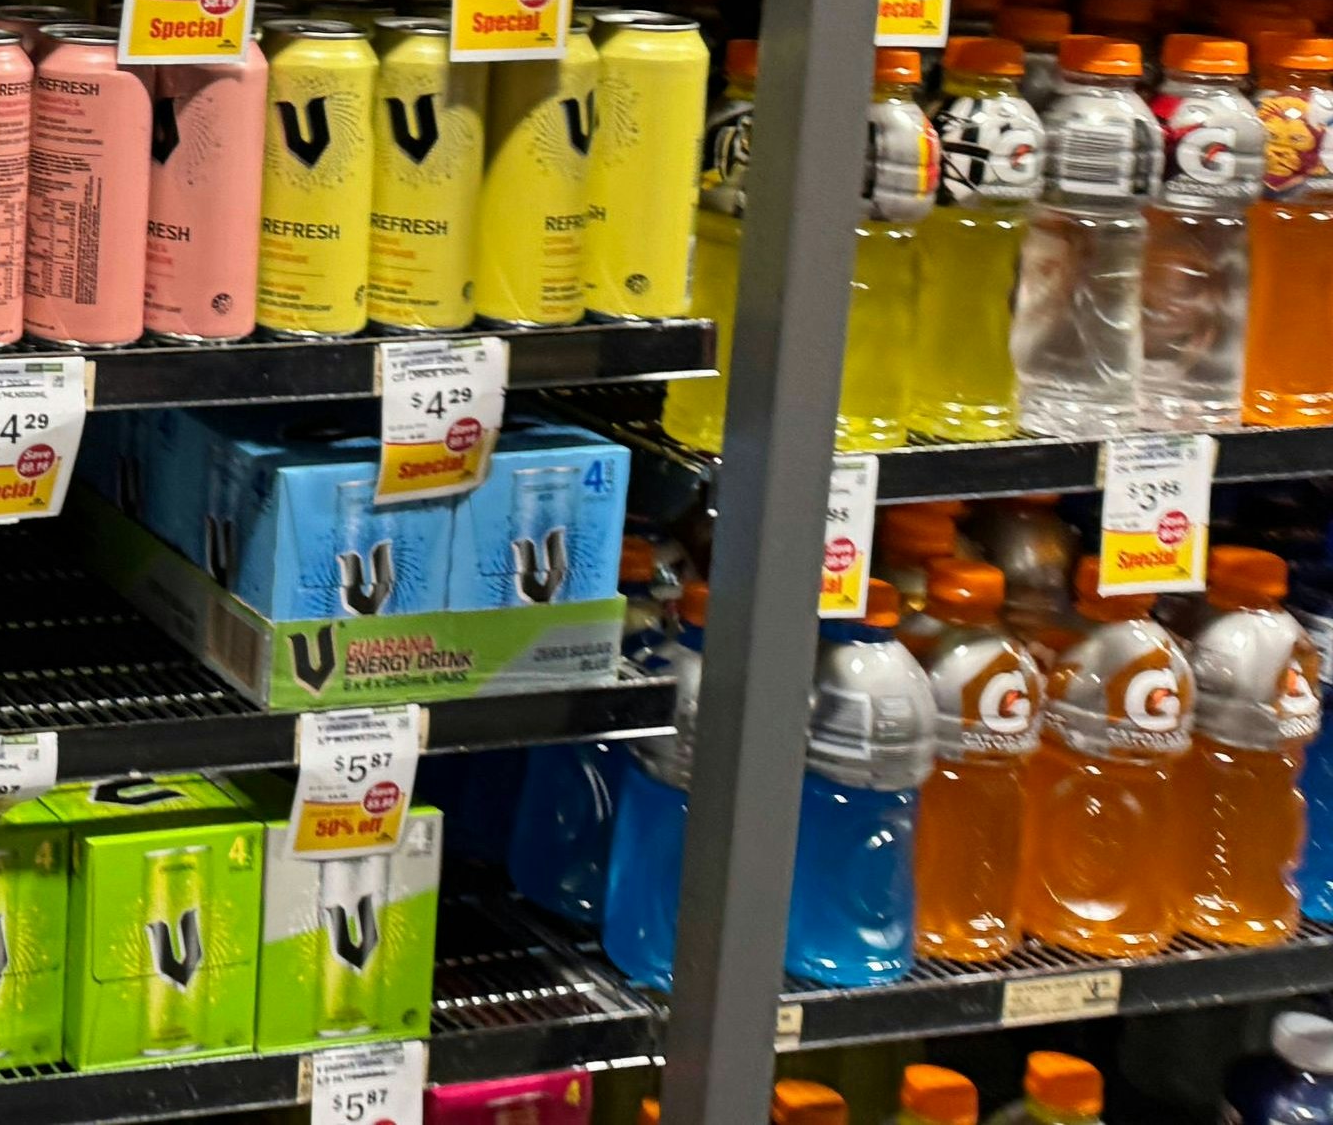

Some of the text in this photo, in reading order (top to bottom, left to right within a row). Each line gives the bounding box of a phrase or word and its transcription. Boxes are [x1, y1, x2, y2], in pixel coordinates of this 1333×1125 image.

[150, 17, 223, 40] Special
[473, 12, 540, 33] Special
[262, 218, 340, 241] REFRESH
[346, 634, 435, 657] GUARANA
[345, 650, 474, 675] ENERGY DRINK
